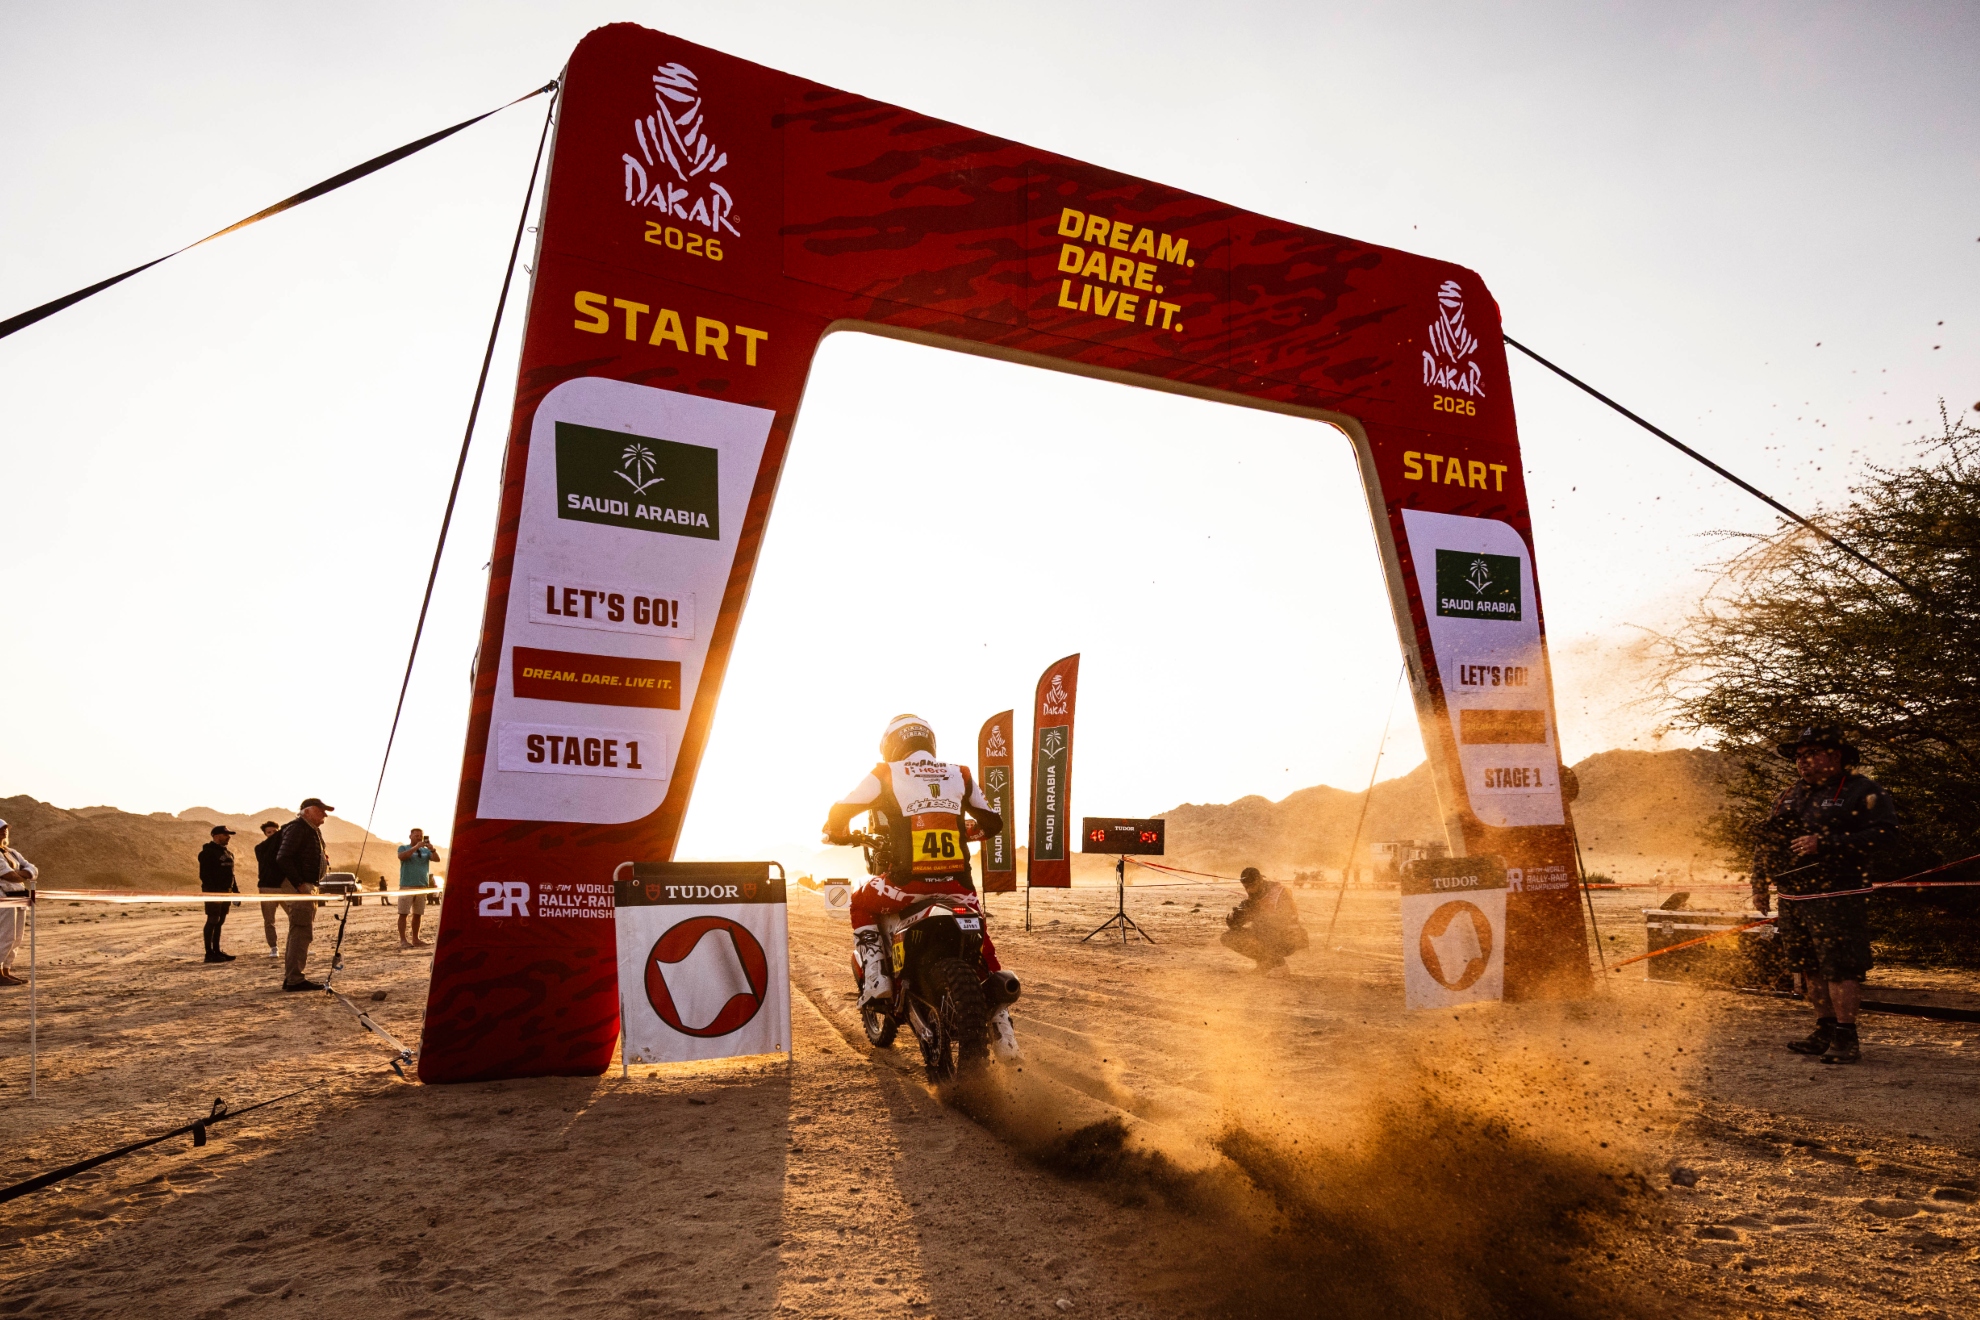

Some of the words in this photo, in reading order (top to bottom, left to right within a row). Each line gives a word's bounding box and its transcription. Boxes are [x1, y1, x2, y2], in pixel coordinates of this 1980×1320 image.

[622, 153, 740, 237] DAKAR
[644, 220, 724, 261] 2026
[1057, 207, 1195, 268] DREAM.
[1057, 243, 1164, 294] DARE.
[1057, 279, 1140, 323] LIVE
[1145, 299, 1183, 332] IT.
[574, 290, 768, 367] START
[1422, 350, 1486, 398] DAKAR
[1433, 394, 1476, 416] 2026
[1403, 450, 1508, 492] START
[567, 493, 629, 517] SAUDI
[634, 504, 710, 528] ARABIA
[546, 585, 625, 622] LET'S
[633, 596, 679, 628] GO!
[1441, 598, 1474, 611] SAUDI
[1476, 601, 1517, 613] ARABIA
[522, 667, 578, 683] DREAM.
[581, 673, 622, 686] DARE.
[625, 677, 656, 688] LIVE
[657, 679, 673, 690] IT.
[1460, 664, 1501, 686] LET'S
[1504, 666, 1528, 687] GO!
[1043, 701, 1068, 716] DAKAR
[526, 733, 618, 768] STAGE
[625, 741, 642, 769] 1
[985, 746, 1008, 757] DAKAR
[1046, 765, 1056, 811] ARABIA
[1484, 767, 1530, 788] STAGE
[1533, 767, 1543, 787] 1
[922, 832, 956, 858] 46
[1046, 814, 1055, 851] SAUDI
[1089, 829, 1105, 842] 46
[994, 835, 1003, 864] SAUDI
[576, 883, 615, 894] WORLD
[665, 885, 739, 899] TUDOR
[1433, 875, 1479, 889] TUDOR
[1526, 873, 1568, 884] RALLY-RAID
[478, 881, 530, 917] 2R
